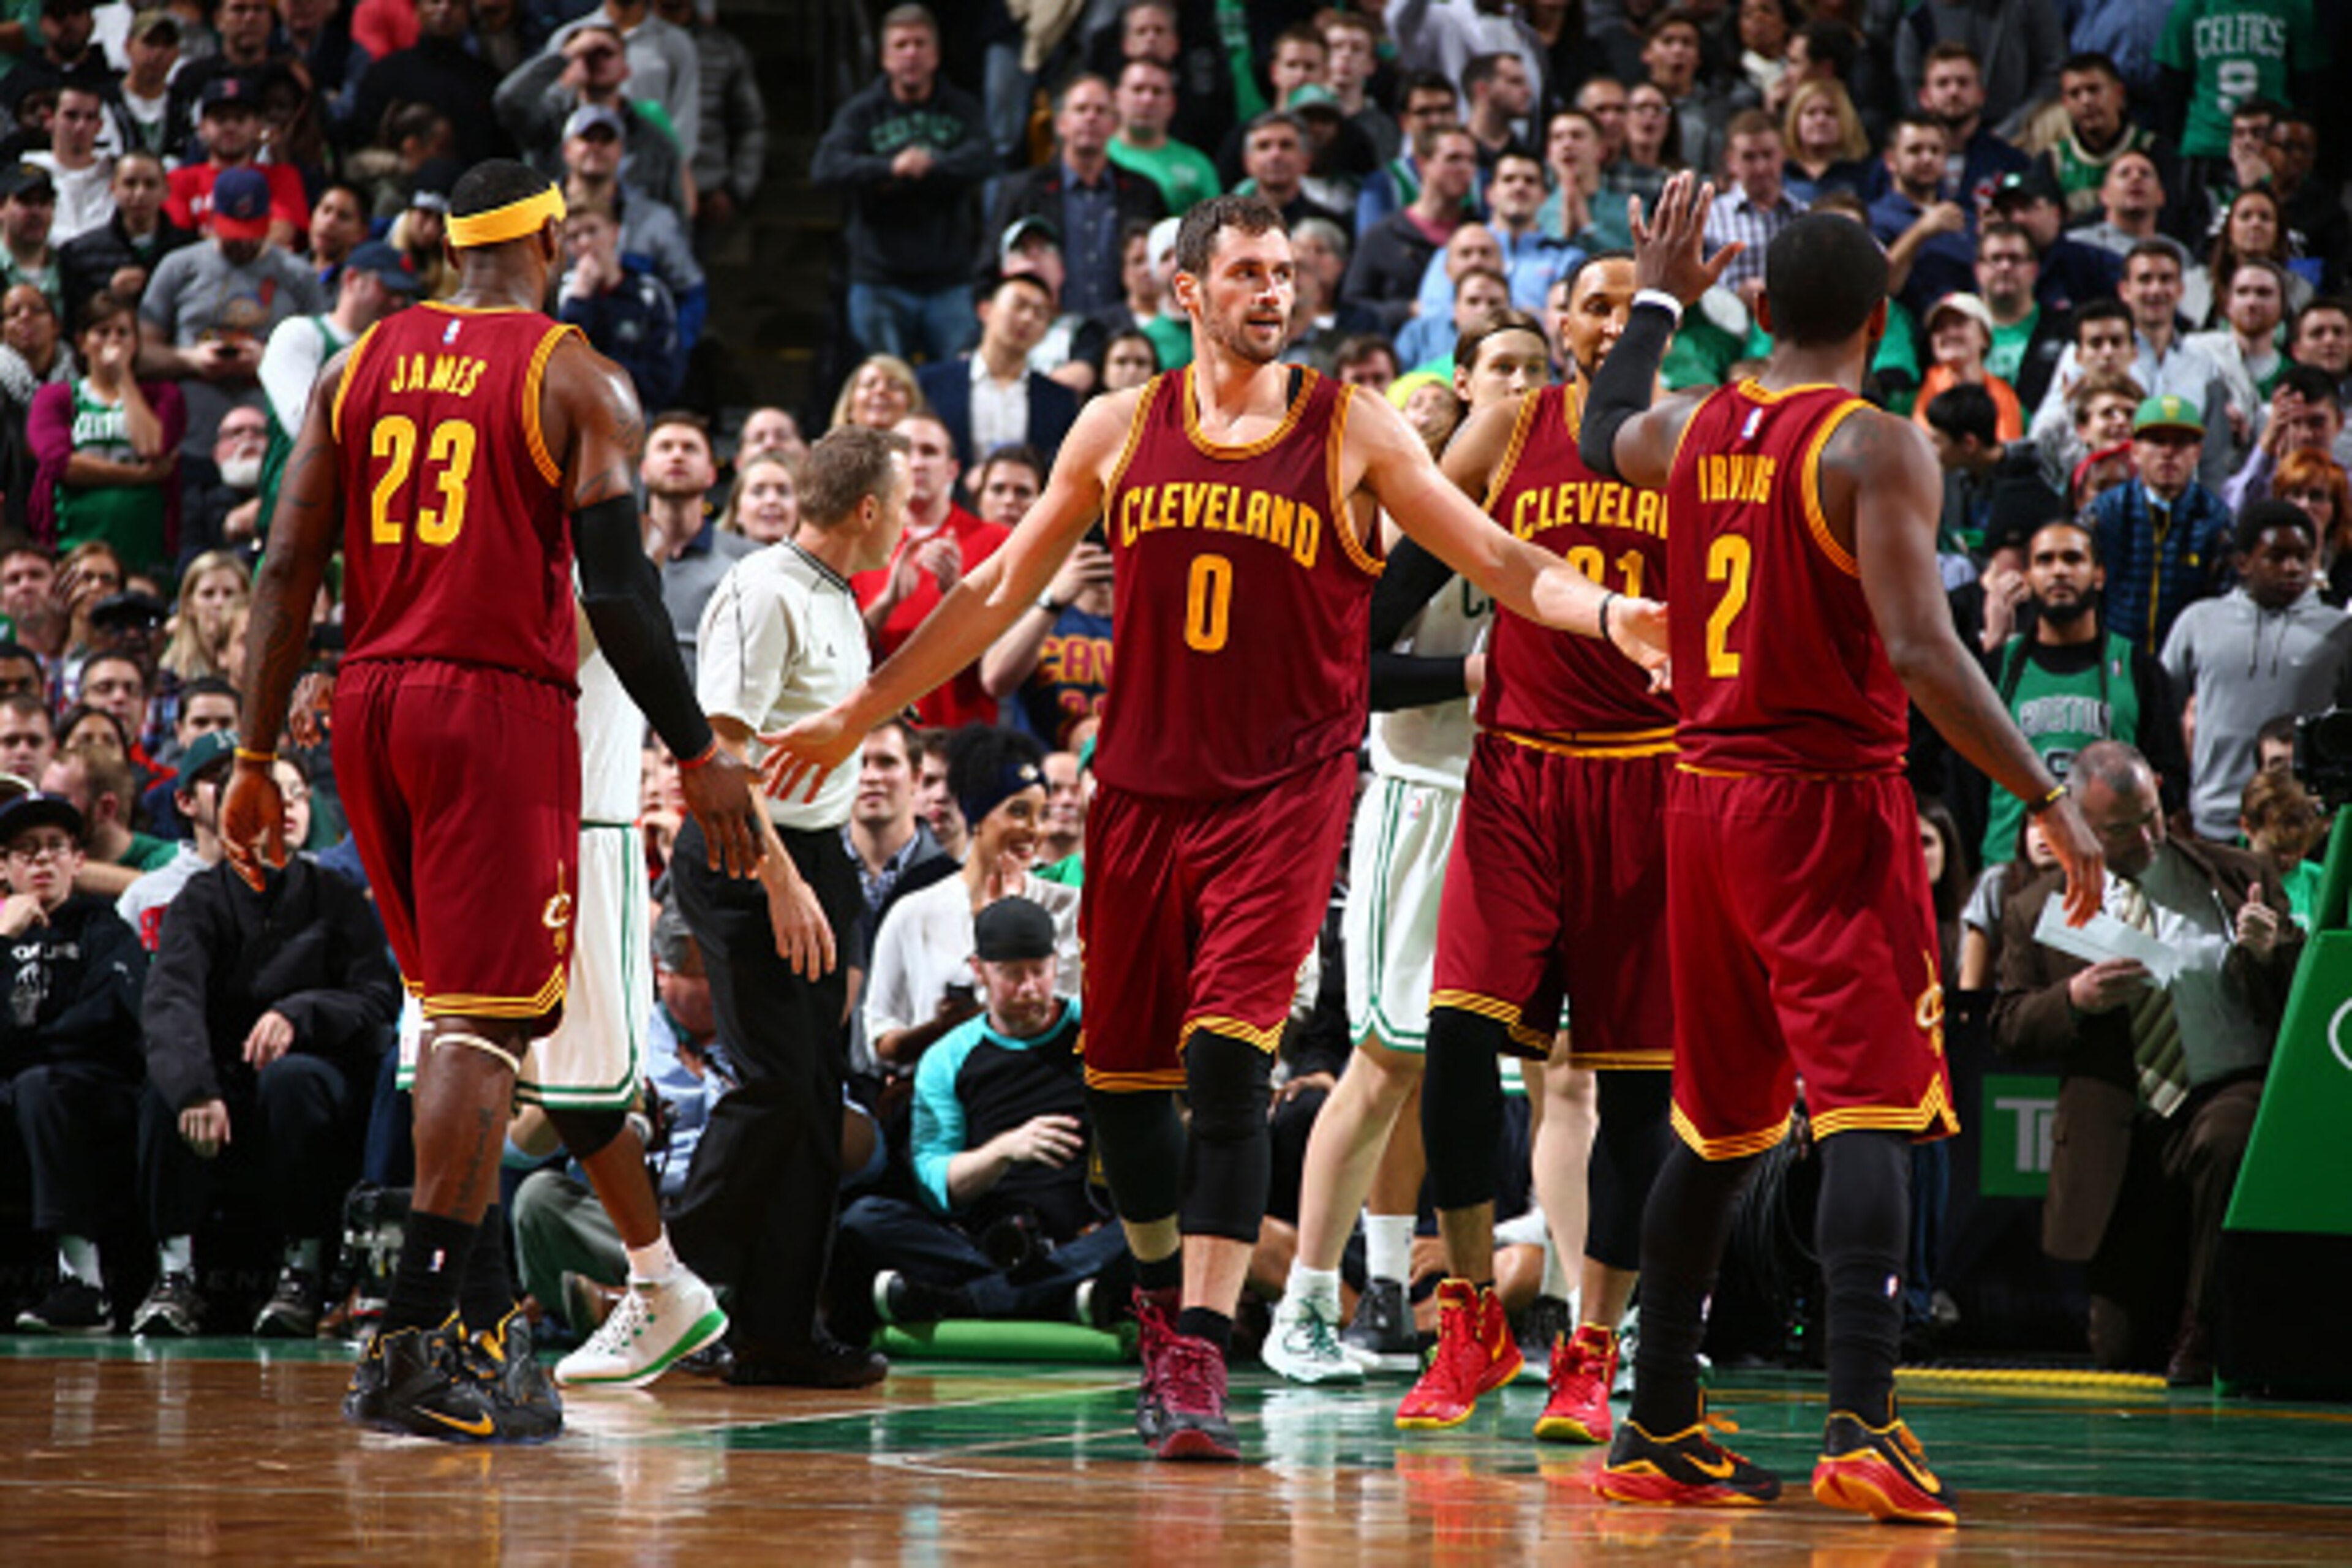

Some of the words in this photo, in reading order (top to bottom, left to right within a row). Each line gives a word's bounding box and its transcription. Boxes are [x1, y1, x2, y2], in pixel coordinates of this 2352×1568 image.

[390, 352, 487, 398] JAMES
[371, 414, 477, 546] 23
[1121, 481, 1321, 570] CLEVELAND
[1698, 453, 1776, 504] IRVING
[1185, 553, 1233, 654] 0
[1706, 533, 1751, 678] 2
